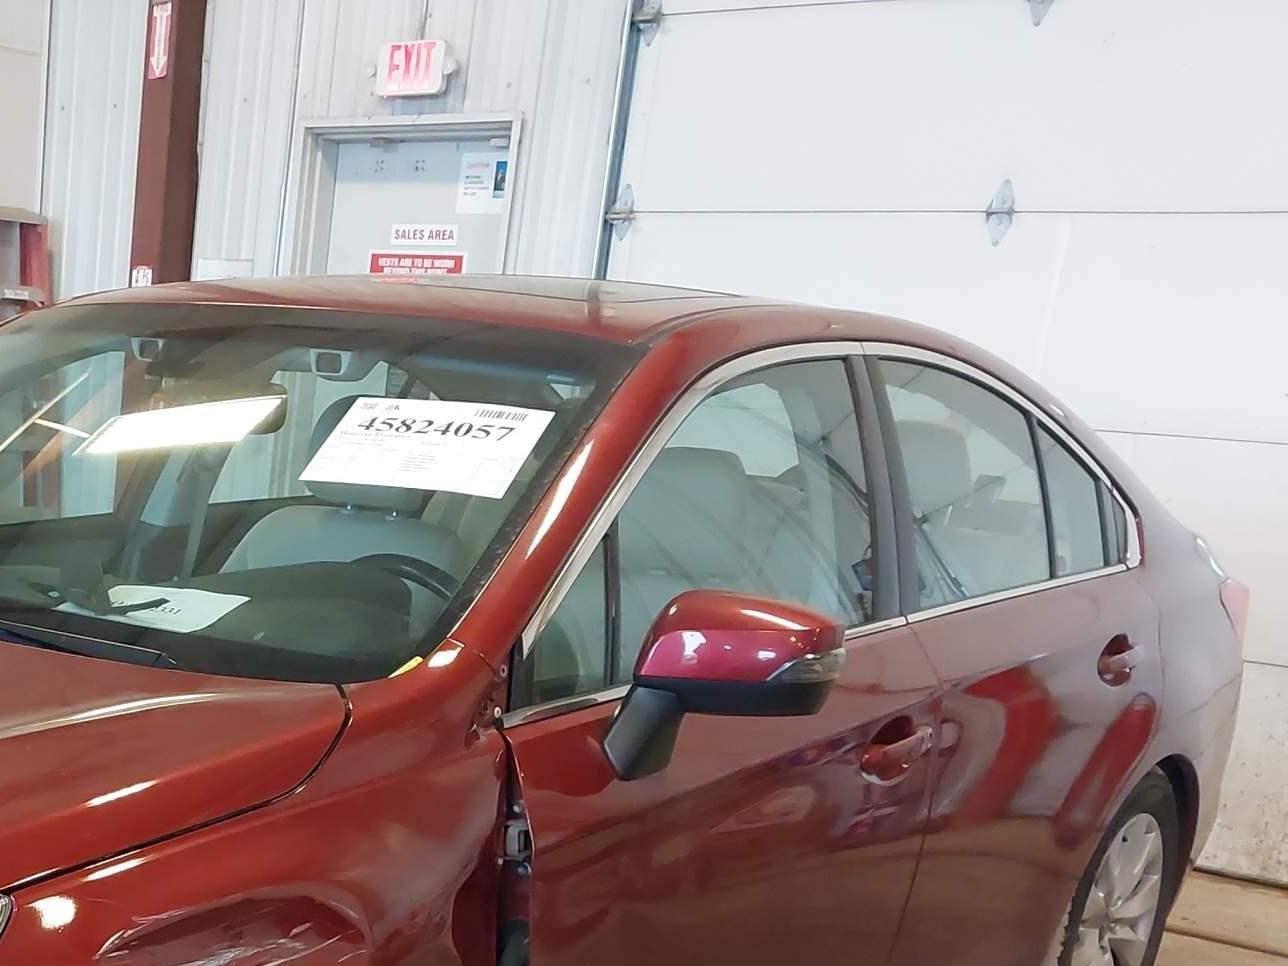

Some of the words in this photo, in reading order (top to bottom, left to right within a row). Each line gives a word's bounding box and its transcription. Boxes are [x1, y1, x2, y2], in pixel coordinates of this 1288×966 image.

[386, 41, 436, 90] EXIT
[394, 228, 425, 241] SALES
[427, 228, 454, 241] AREA
[357, 416, 516, 442] 45824057
